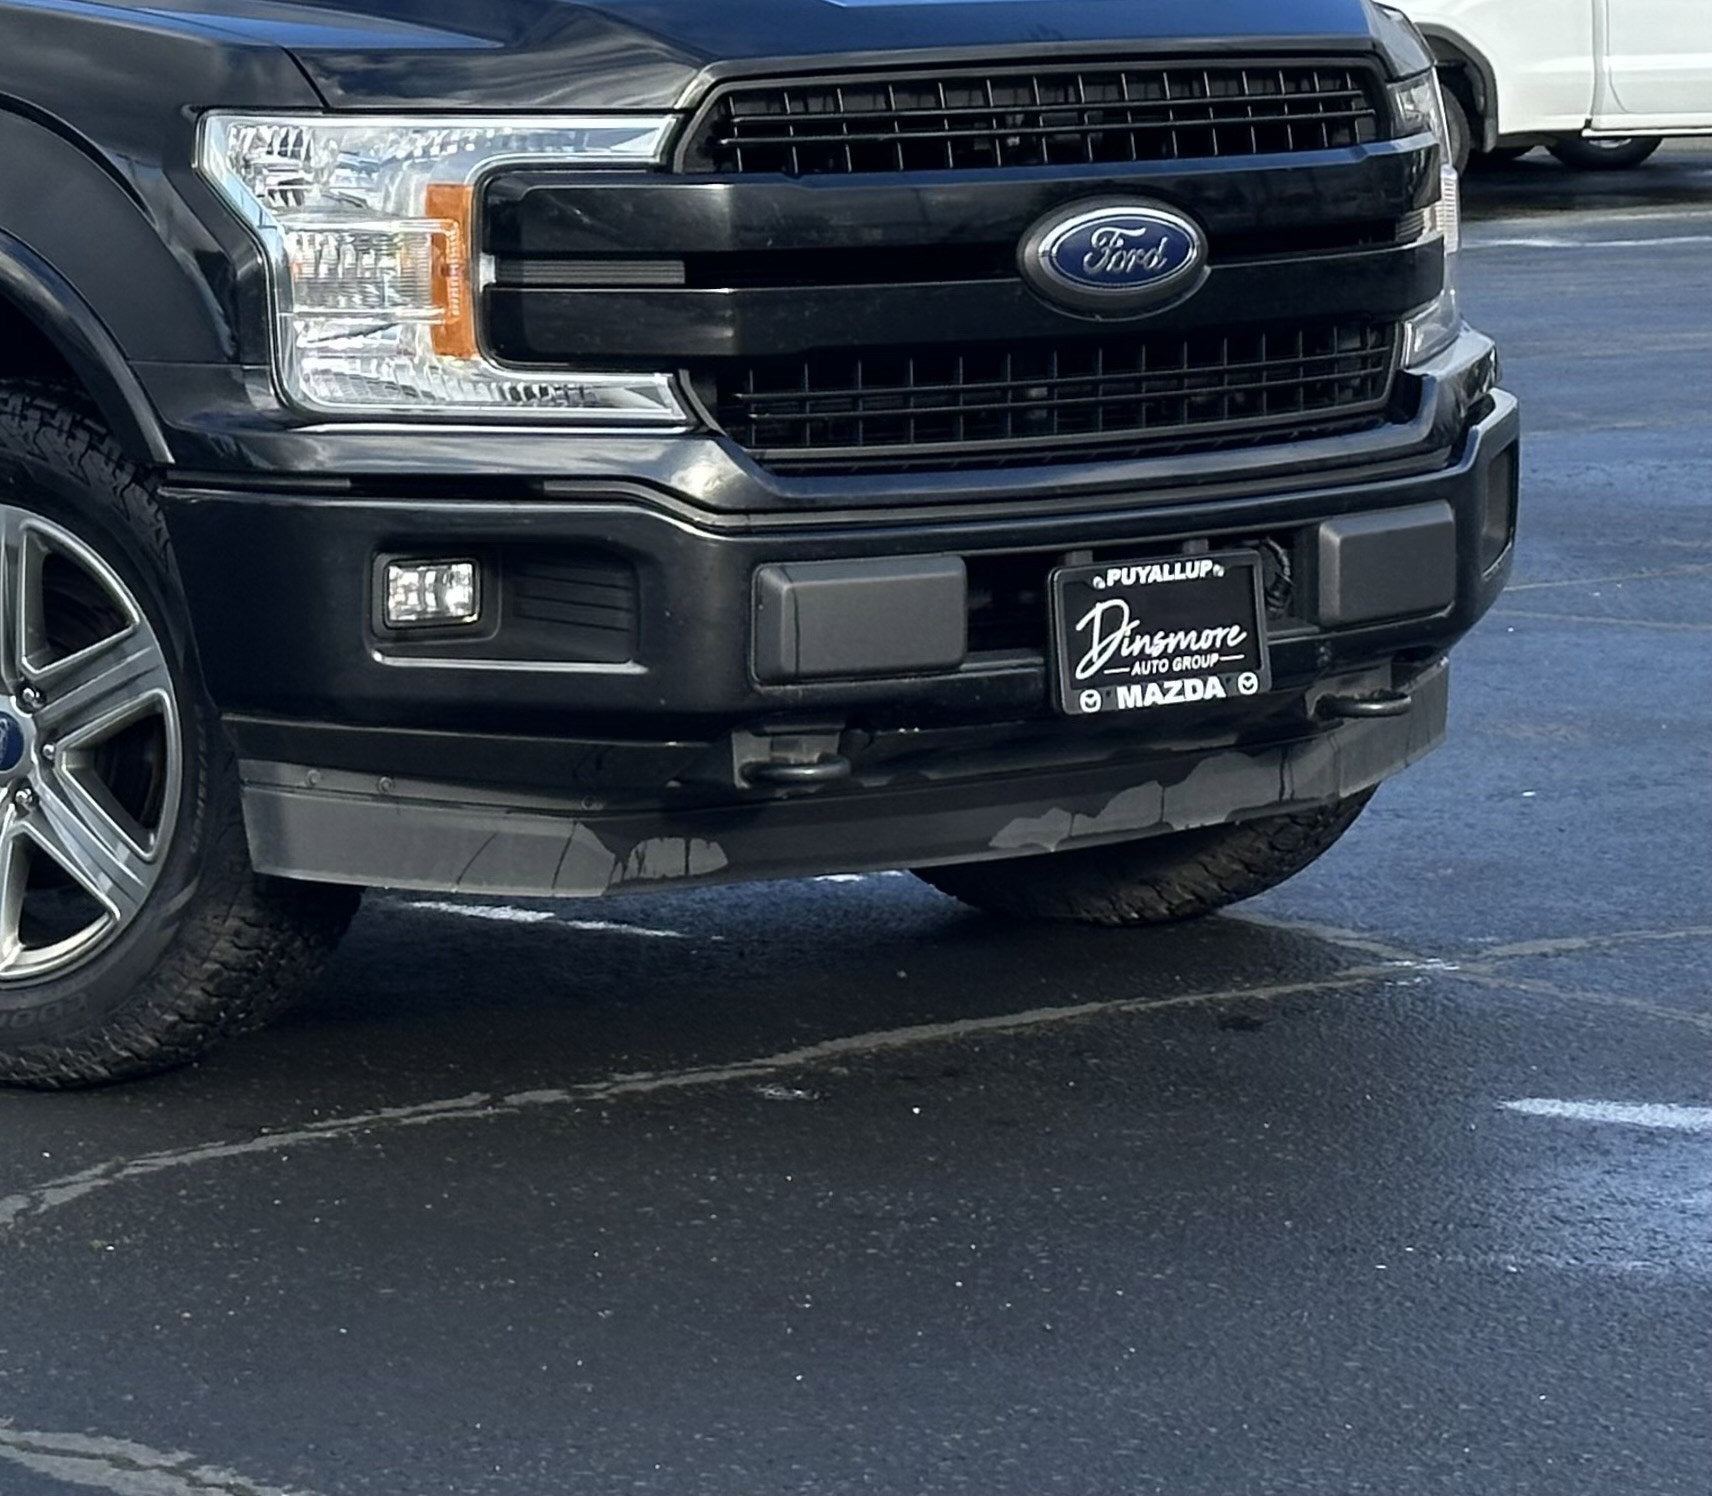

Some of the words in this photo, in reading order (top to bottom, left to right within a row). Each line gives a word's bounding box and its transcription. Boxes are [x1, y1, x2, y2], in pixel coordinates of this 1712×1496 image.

[1083, 226, 1169, 274] Ford
[1107, 559, 1213, 587] PUYALLUP
[1075, 598, 1248, 680] Dinsmore
[1131, 657, 1170, 676] AUTO
[1172, 653, 1220, 671] GROUP
[1116, 675, 1227, 710] MAZDA
